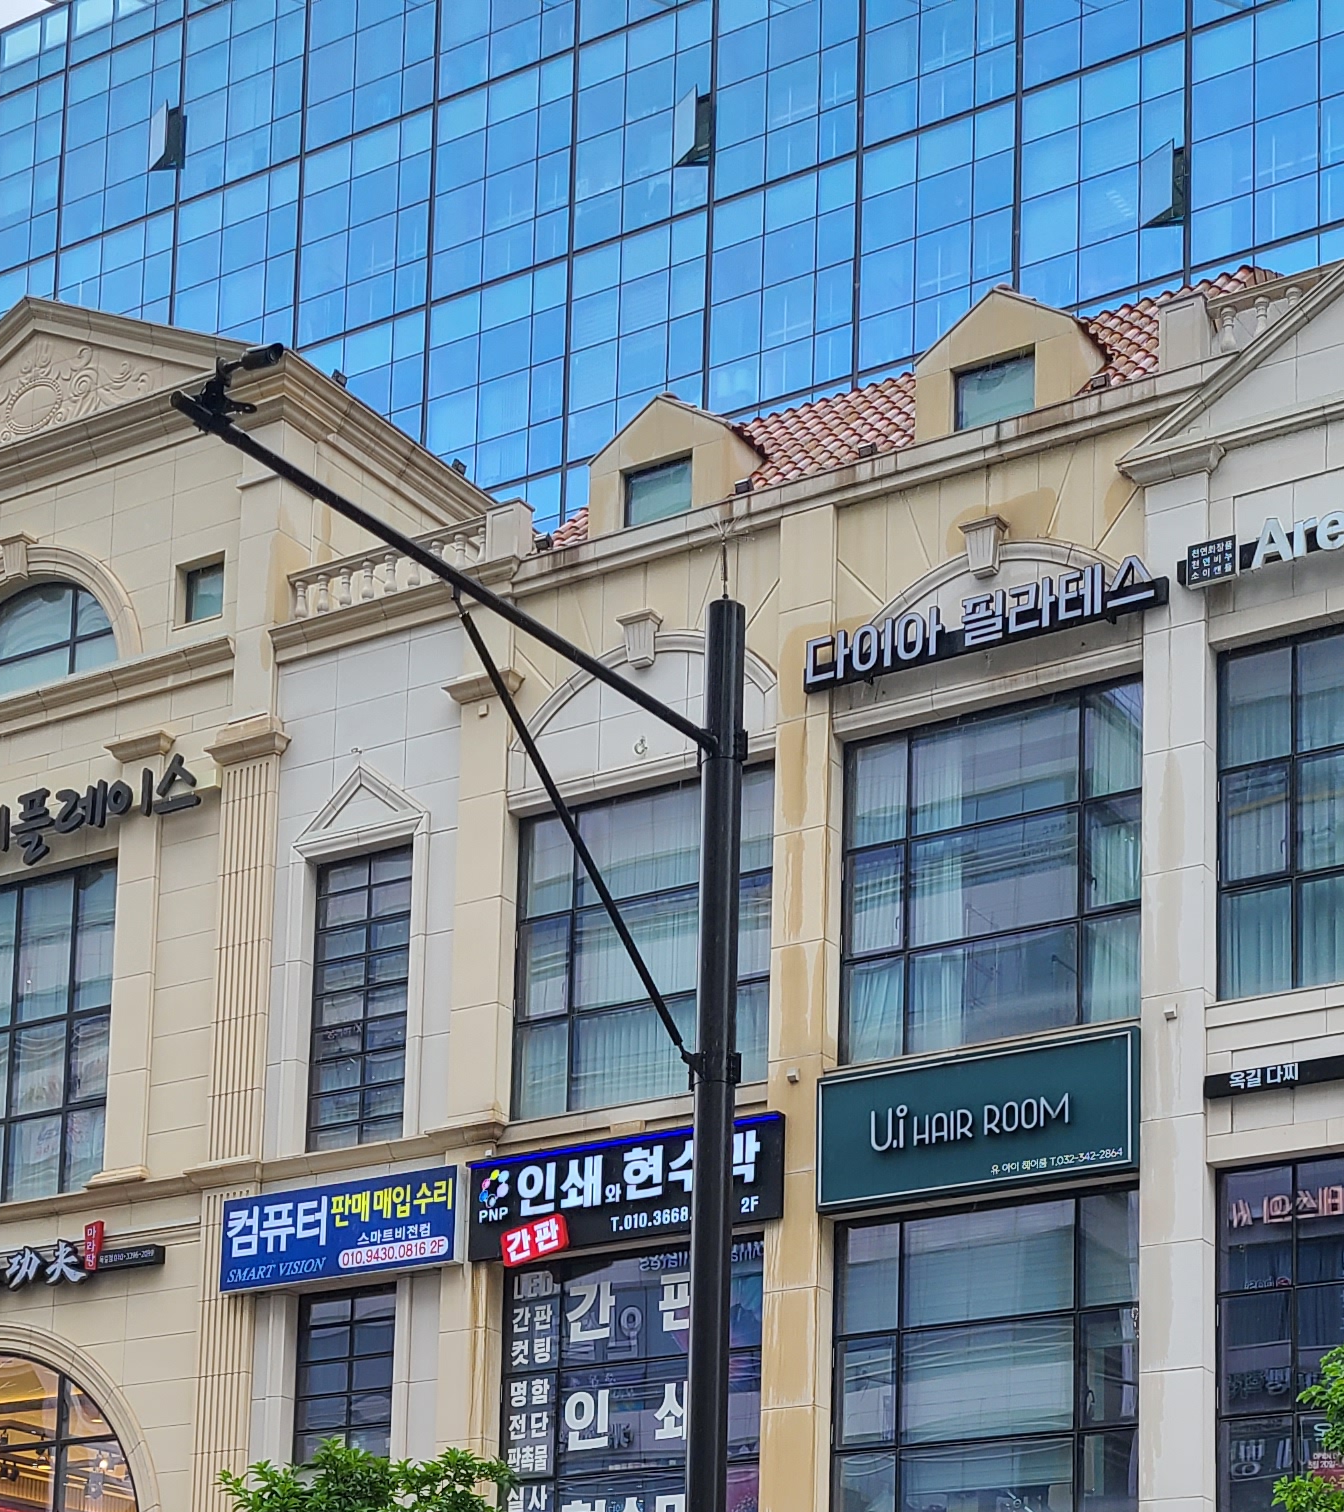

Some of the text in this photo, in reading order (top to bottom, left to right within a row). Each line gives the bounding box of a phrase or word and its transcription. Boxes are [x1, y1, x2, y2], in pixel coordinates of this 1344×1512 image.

[805, 554, 1155, 684] 다이아 필라테스
[1229, 1062, 1299, 1089] 옥길 다찌
[912, 1092, 1071, 1147] HAIR ROOM
[227, 1178, 453, 1258] 컴퓨터 판매 매입 수리
[478, 1207, 508, 1223] PNP
[740, 1196, 759, 1214] 2F
[342, 1239, 445, 1266] 010.9430.0816 2F
[506, 1218, 560, 1263] 간판
[227, 1257, 326, 1283] SMART VISION
[513, 1270, 555, 1301] LED
[512, 1303, 553, 1334] 간판
[510, 1379, 550, 1408] 명함
[508, 1411, 549, 1441] 전단
[506, 1481, 547, 1512] 실사
